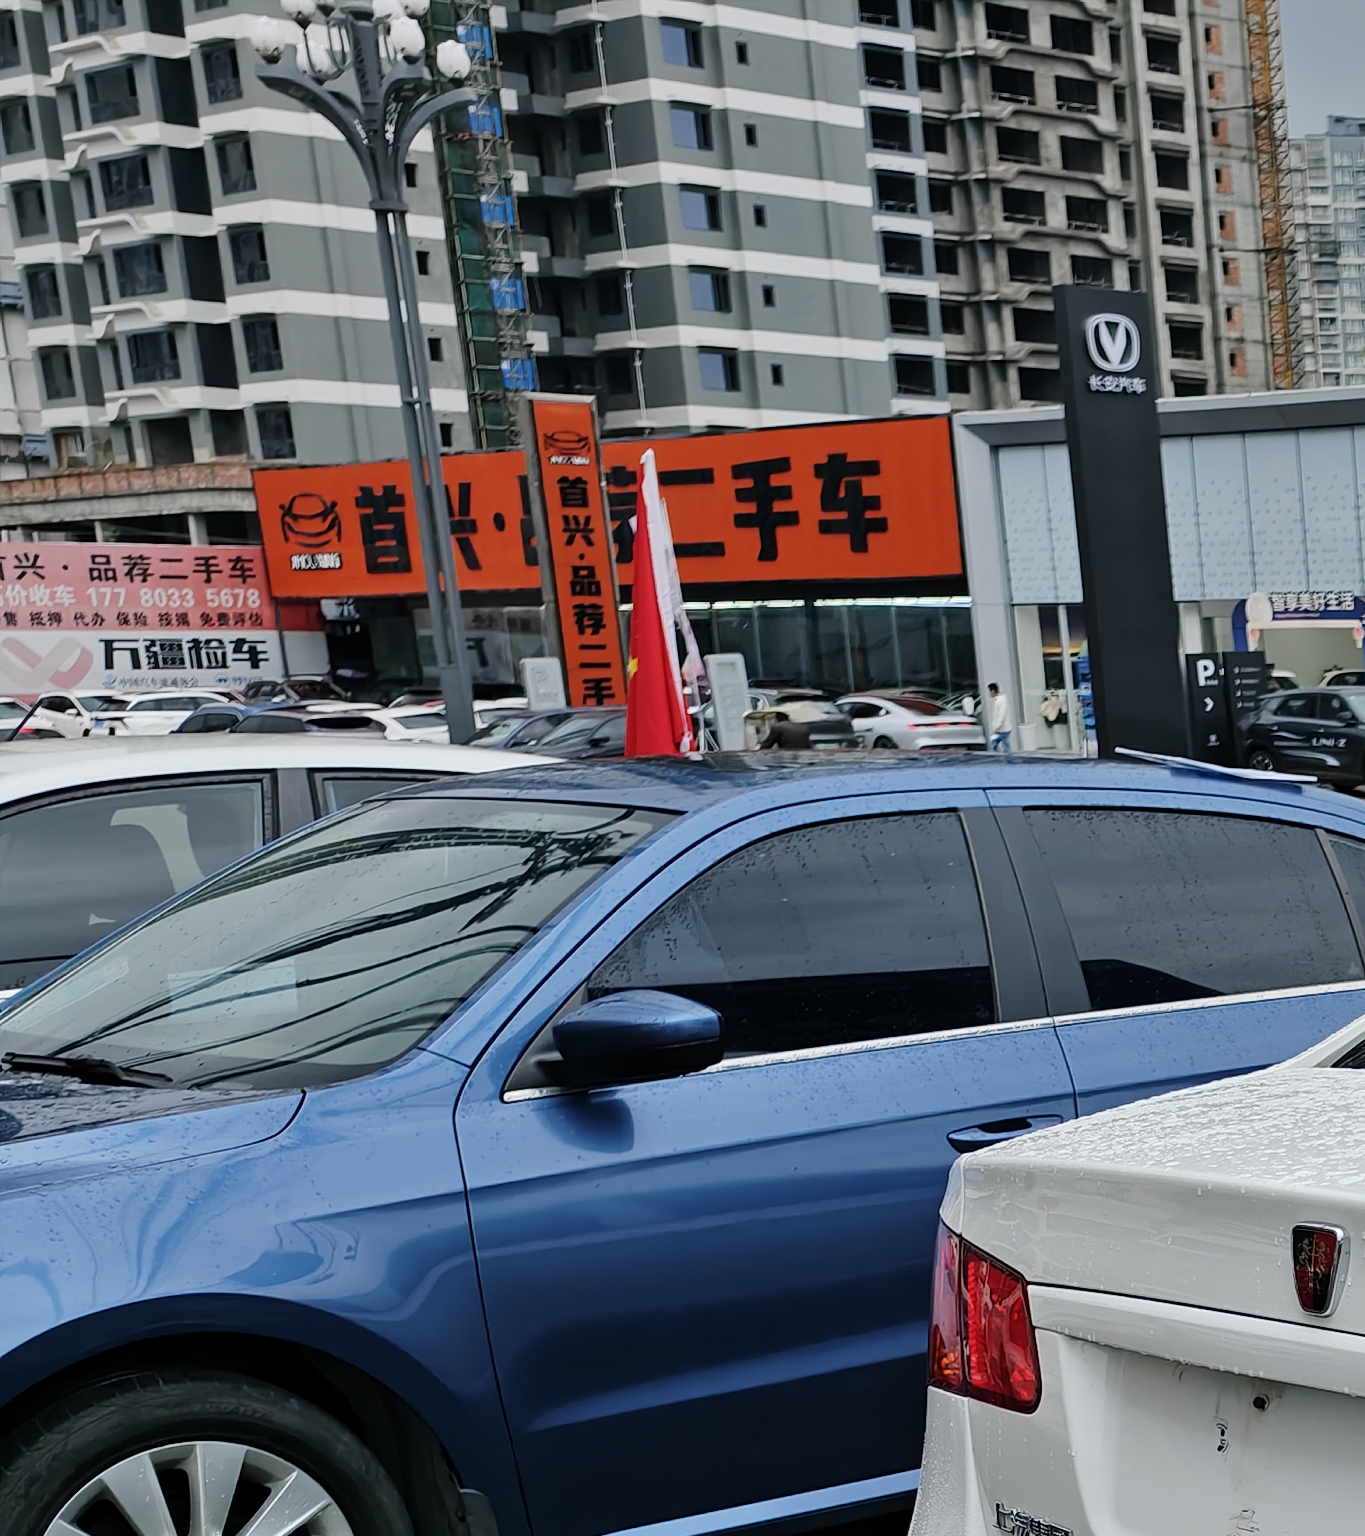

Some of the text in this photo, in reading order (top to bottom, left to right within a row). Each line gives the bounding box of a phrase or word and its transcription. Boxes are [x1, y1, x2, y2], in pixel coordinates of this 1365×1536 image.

[1087, 374, 1147, 394] 长安汽车
[0, 553, 256, 584] 兴·品荐二手车
[86, 588, 127, 608] 177
[140, 588, 195, 608] 8033
[206, 588, 260, 608] 5678
[1196, 658, 1215, 686] P
